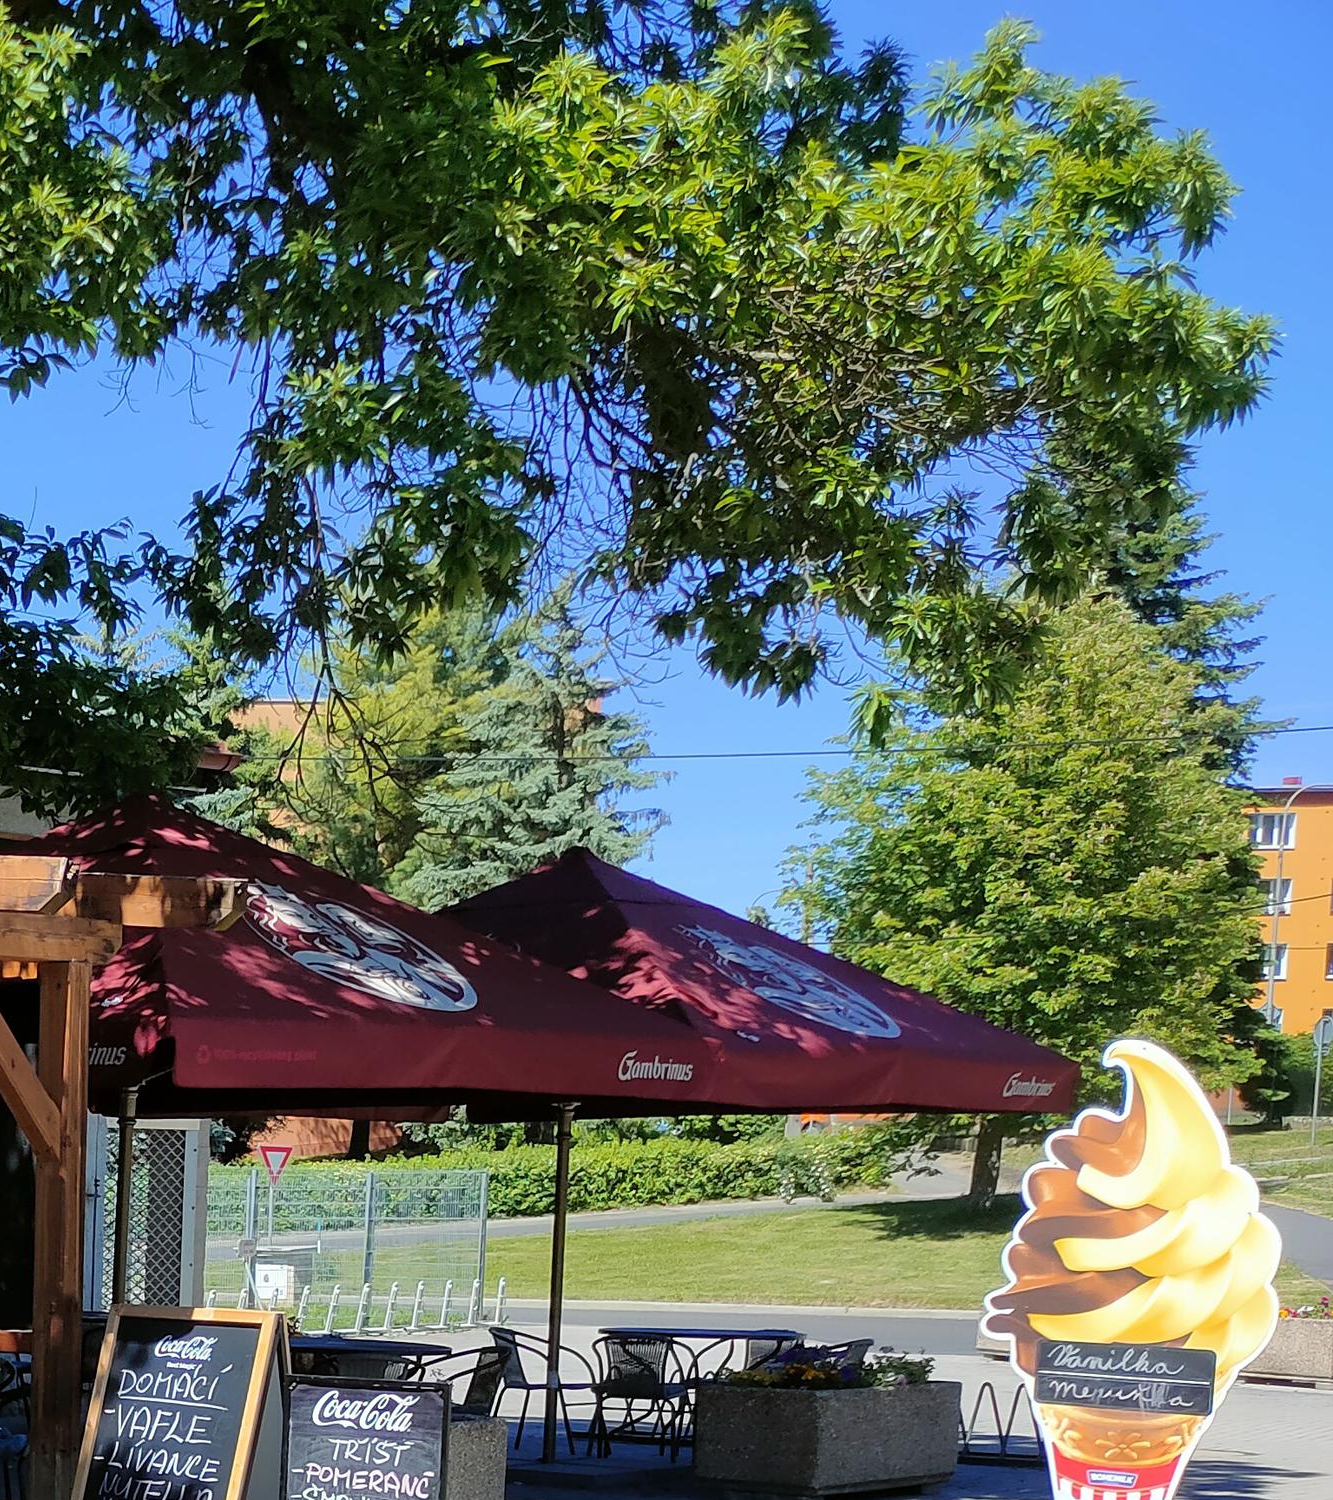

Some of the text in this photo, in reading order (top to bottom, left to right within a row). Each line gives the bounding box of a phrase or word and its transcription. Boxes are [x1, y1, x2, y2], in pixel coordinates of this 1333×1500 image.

[618, 1050, 694, 1081] Gambrinus
[154, 1335, 218, 1361] Coca-Cola
[1047, 1344, 1185, 1375] Vanilka
[117, 1364, 233, 1401] DOMÁCÍ
[312, 1390, 420, 1432] Coca-Cola
